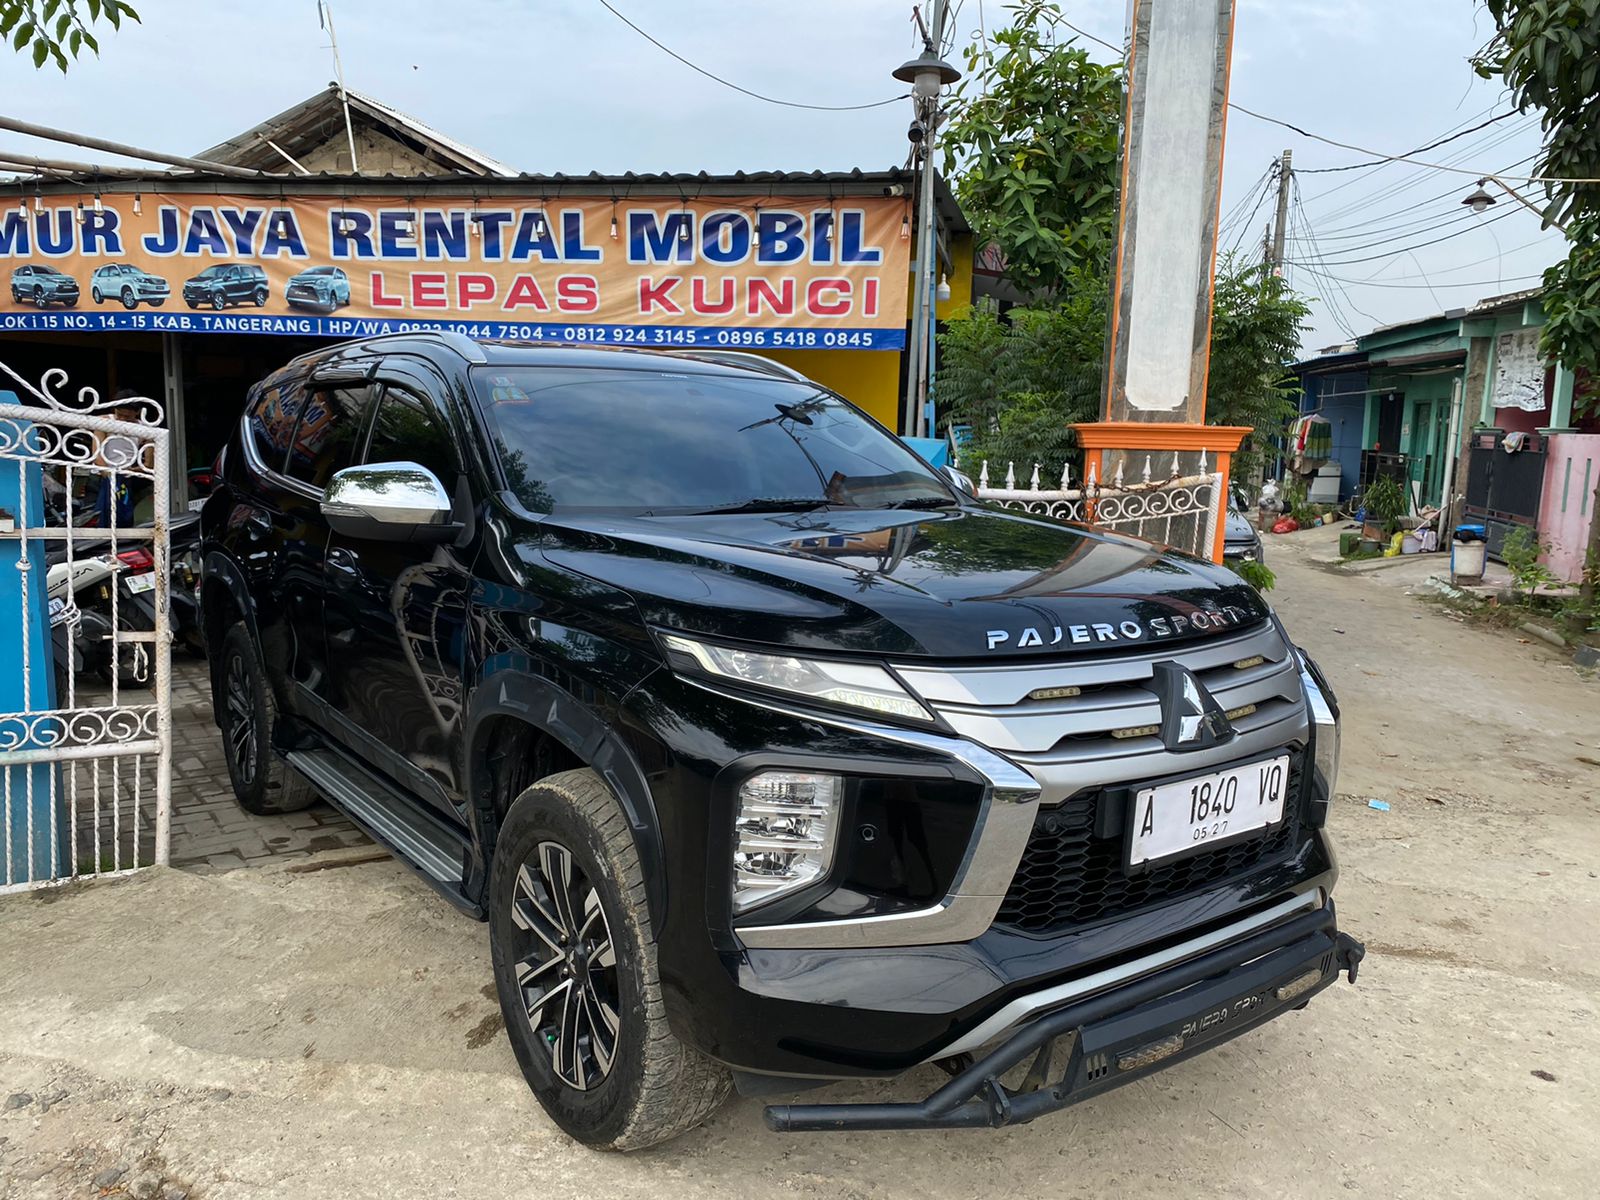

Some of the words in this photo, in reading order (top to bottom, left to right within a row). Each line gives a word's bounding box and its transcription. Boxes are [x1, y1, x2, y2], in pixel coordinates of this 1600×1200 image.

[0, 206, 124, 257] MUR
[143, 205, 308, 258] JAYA
[328, 207, 602, 263] RENTAL
[626, 208, 883, 266] MOBIL
[370, 272, 600, 312] LEPAS
[638, 277, 879, 317] KUNCI
[42, 315, 58, 328] 15
[63, 315, 93, 328] NO.
[98, 315, 116, 328] 14
[131, 315, 146, 328] 15
[153, 315, 197, 329] KAB.
[202, 317, 311, 332] TANGERANG
[328, 320, 393, 336] HP/WA
[448, 324, 491, 338] 1044
[498, 325, 543, 340] 7504
[564, 327, 606, 341] 0812
[612, 329, 647, 342] 924
[654, 329, 697, 343] 3145
[717, 331, 765, 345] 0896
[772, 332, 816, 346] 5418
[823, 332, 873, 347] 0845
[986, 620, 1142, 650] PAJERO
[1149, 605, 1240, 636] SPORT
[1140, 795, 1154, 838] A
[1189, 775, 1238, 825] 1840
[1259, 764, 1282, 806] VQ
